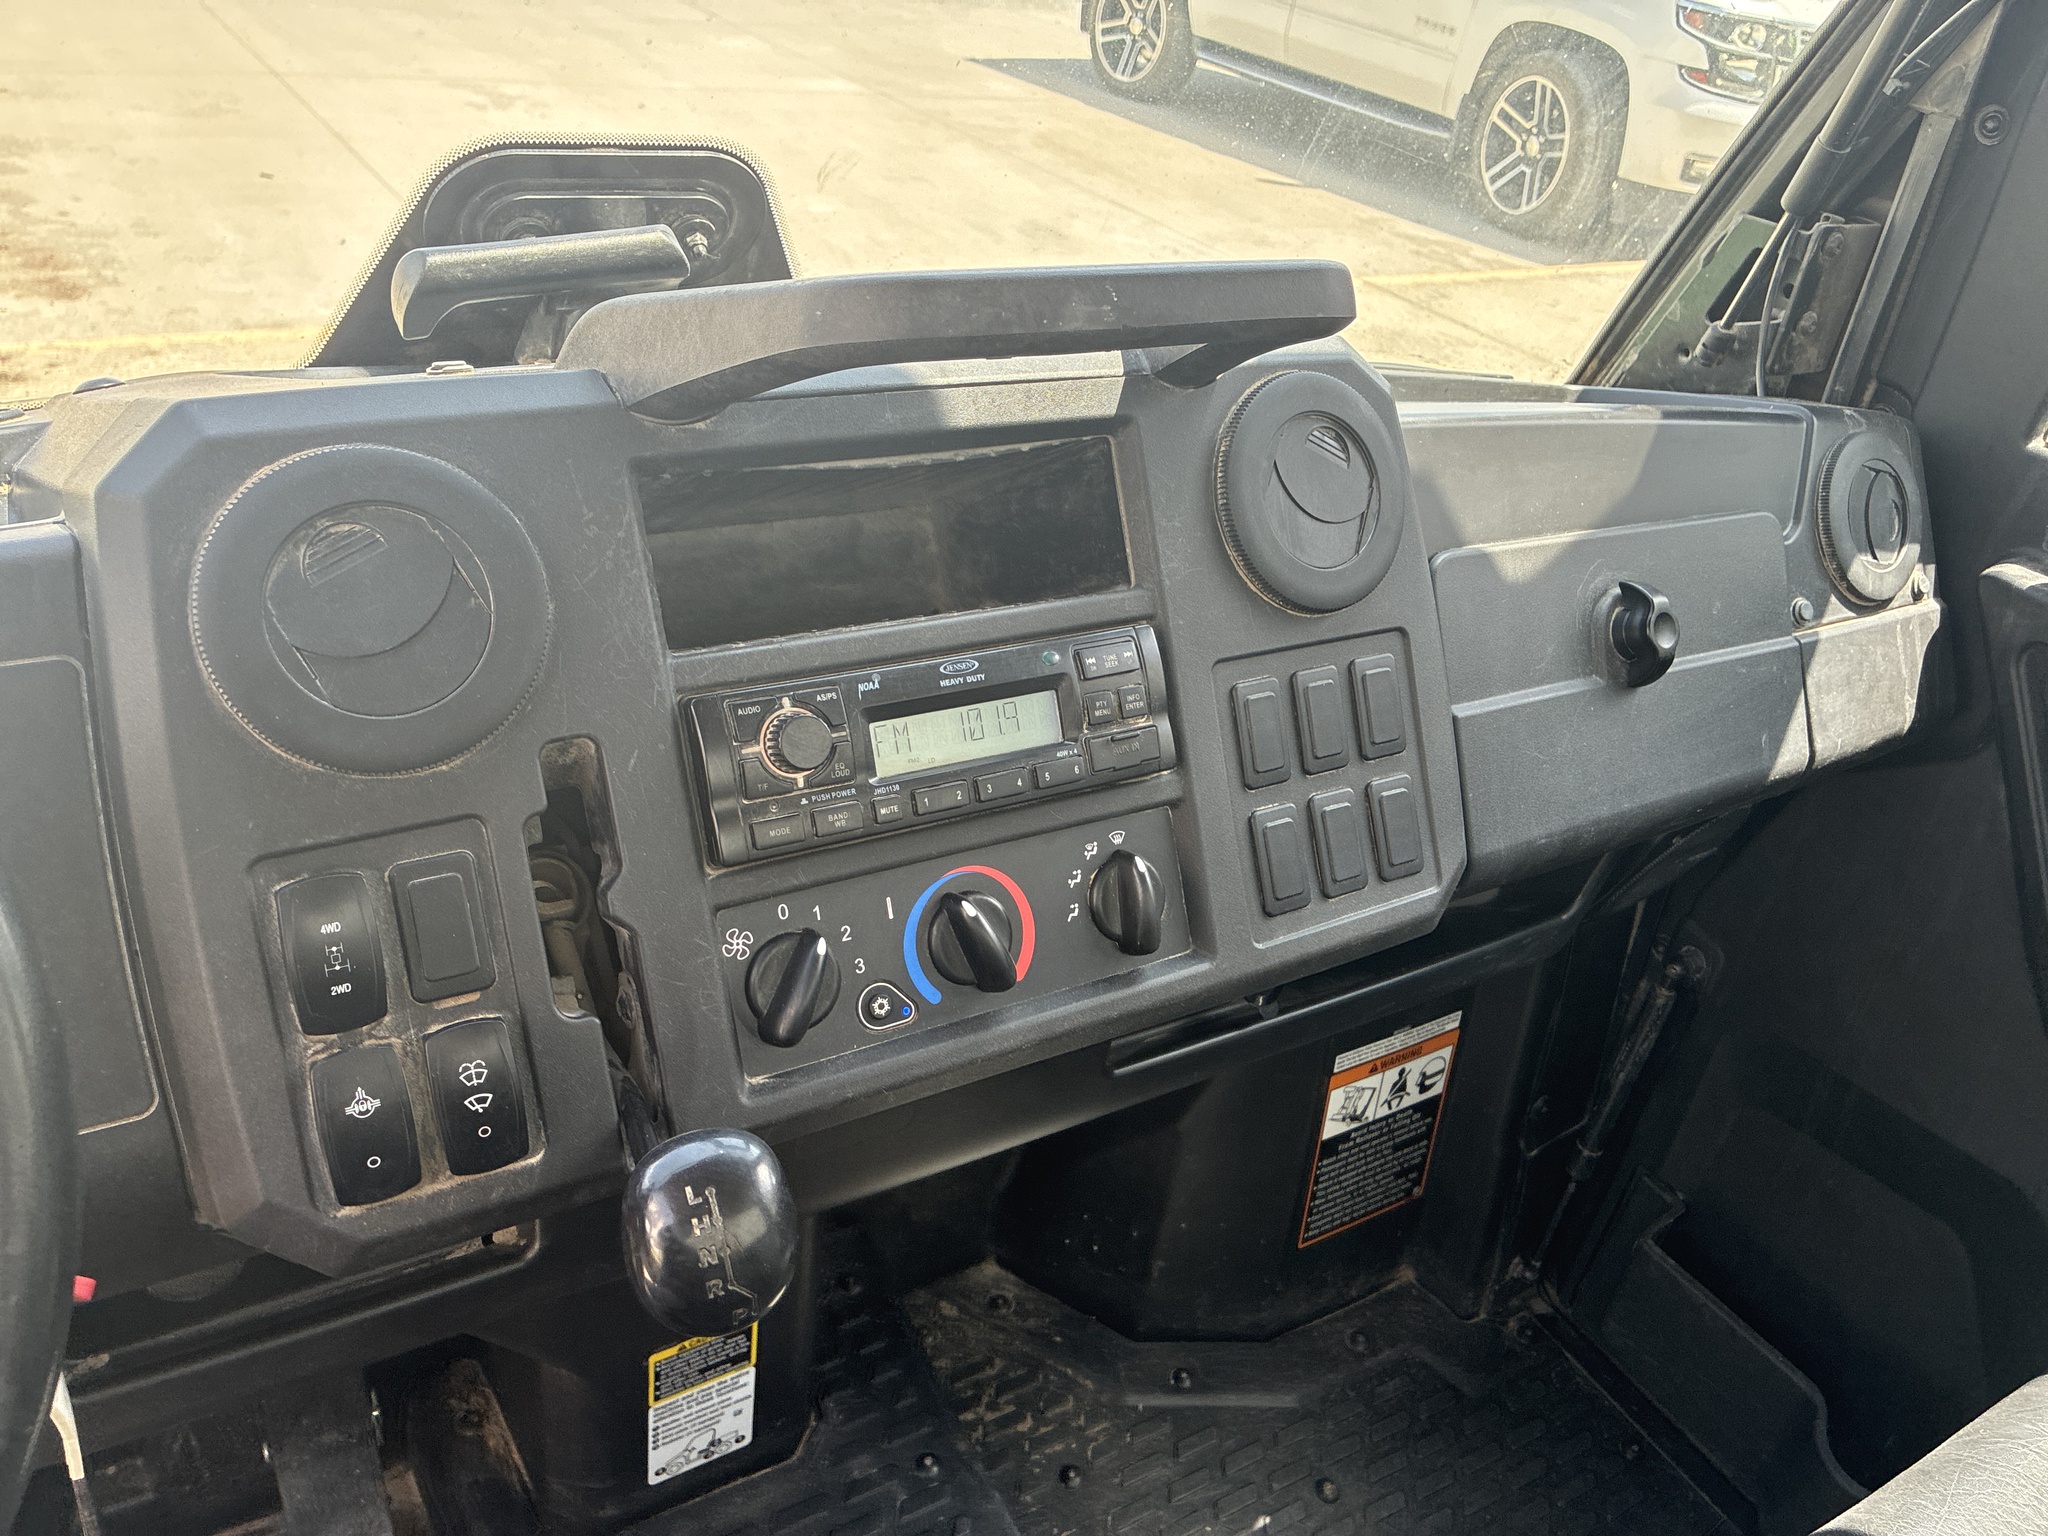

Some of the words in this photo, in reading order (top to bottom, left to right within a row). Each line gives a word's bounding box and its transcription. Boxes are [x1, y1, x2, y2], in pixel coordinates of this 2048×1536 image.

[940, 678, 964, 687] HEAVY
[966, 674, 985, 683] DUTY
[858, 680, 880, 697] NOAA
[816, 692, 837, 702] AS/PS
[738, 706, 761, 716] AUDIO
[1094, 708, 1111, 717] MENU
[1125, 702, 1144, 711] ENTER
[874, 722, 912, 758] FM
[831, 769, 850, 778] LOUD
[1074, 764, 1080, 774] 6
[1017, 777, 1023, 787] 4
[1044, 771, 1051, 781] 5
[873, 784, 900, 796] JHD1130
[986, 783, 993, 793] 3
[812, 793, 831, 803] PUSH
[831, 788, 857, 799] POWER
[956, 790, 963, 800] 2
[828, 812, 849, 821] BAND
[880, 806, 899, 815] MUTE
[834, 820, 847, 828] WB
[769, 827, 791, 837] MODE
[777, 904, 789, 920] 0
[812, 904, 821, 921] 1
[320, 921, 342, 935] 4WD
[840, 925, 852, 942] 2
[854, 958, 866, 974] 3
[330, 982, 352, 996] 2WD
[1380, 1044, 1423, 1069] WARNING
[684, 1185, 703, 1206] L
[690, 1214, 711, 1237] H
[698, 1245, 719, 1268] N
[705, 1279, 725, 1299] R
[732, 1307, 748, 1325] P
